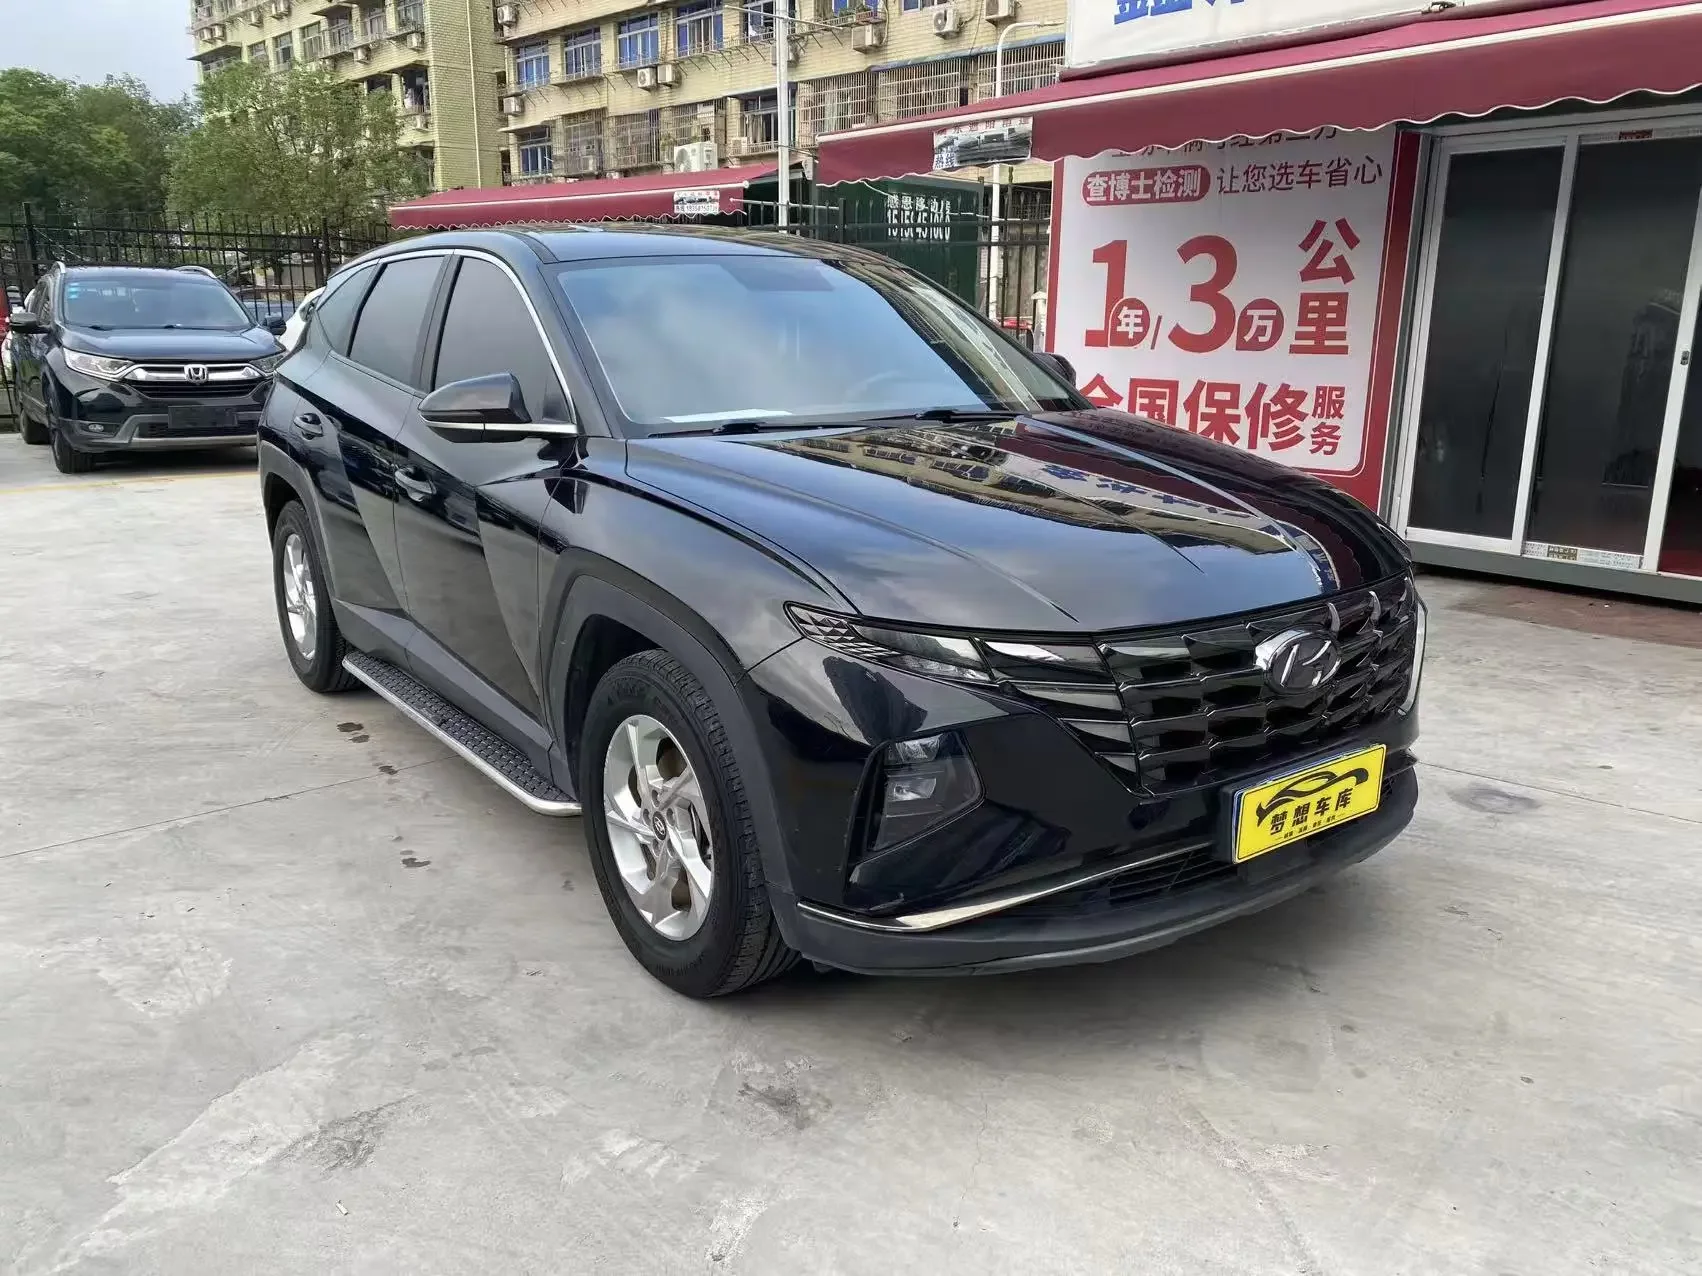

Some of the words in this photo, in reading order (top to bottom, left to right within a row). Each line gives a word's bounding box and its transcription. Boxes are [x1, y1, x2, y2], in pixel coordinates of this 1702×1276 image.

[1086, 168, 1201, 202] 查博士检测
[1217, 155, 1383, 195] 让您选车省心
[1270, 788, 1353, 836] 梦想车库
